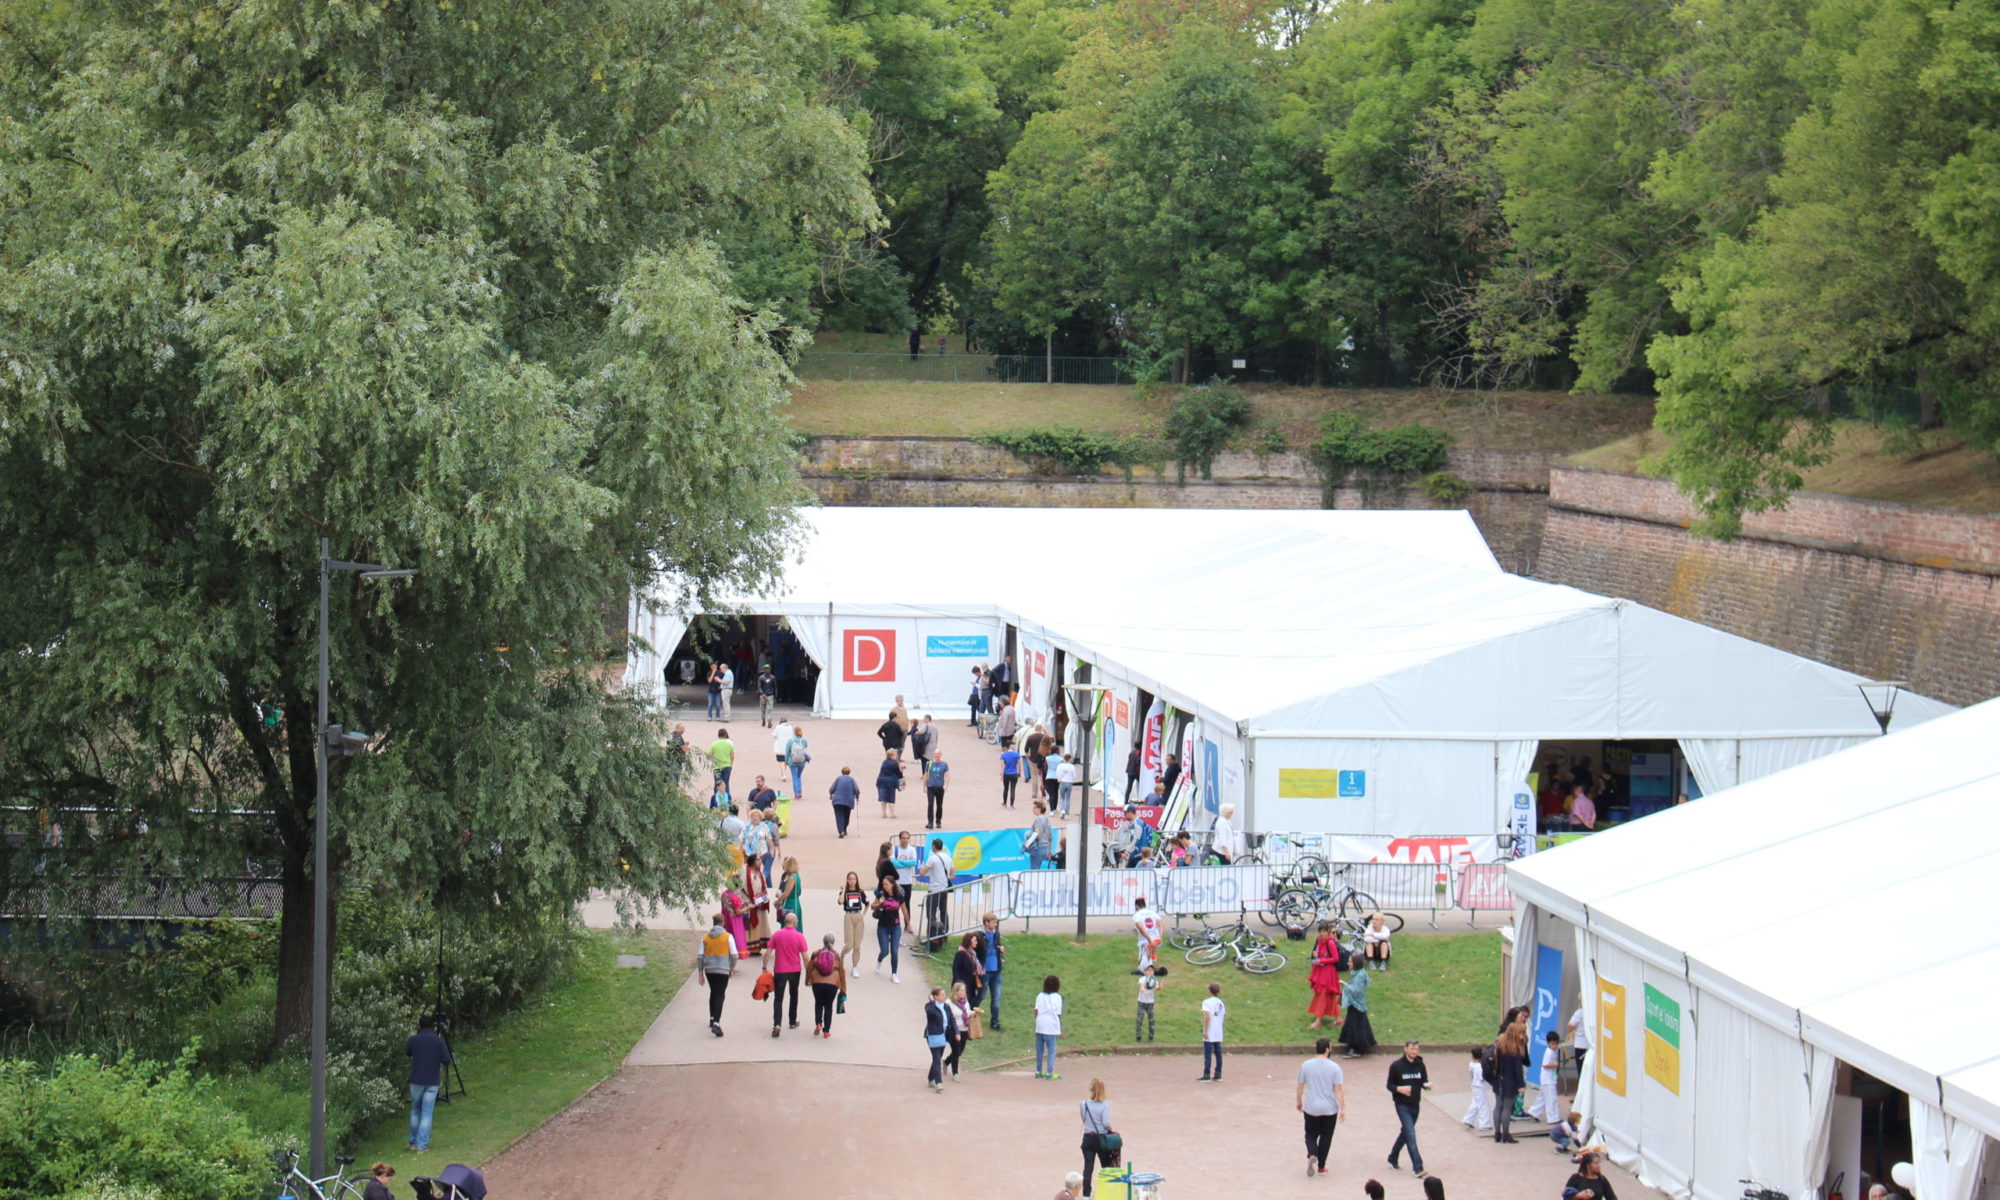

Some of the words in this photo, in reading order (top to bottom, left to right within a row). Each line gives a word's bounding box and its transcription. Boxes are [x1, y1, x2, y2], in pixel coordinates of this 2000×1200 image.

[853, 635, 886, 676] D
[1147, 715, 1163, 780] MAIF
[1206, 751, 1216, 805] A
[1375, 842, 1473, 865] MAIF
[1601, 990, 1617, 1080] E
